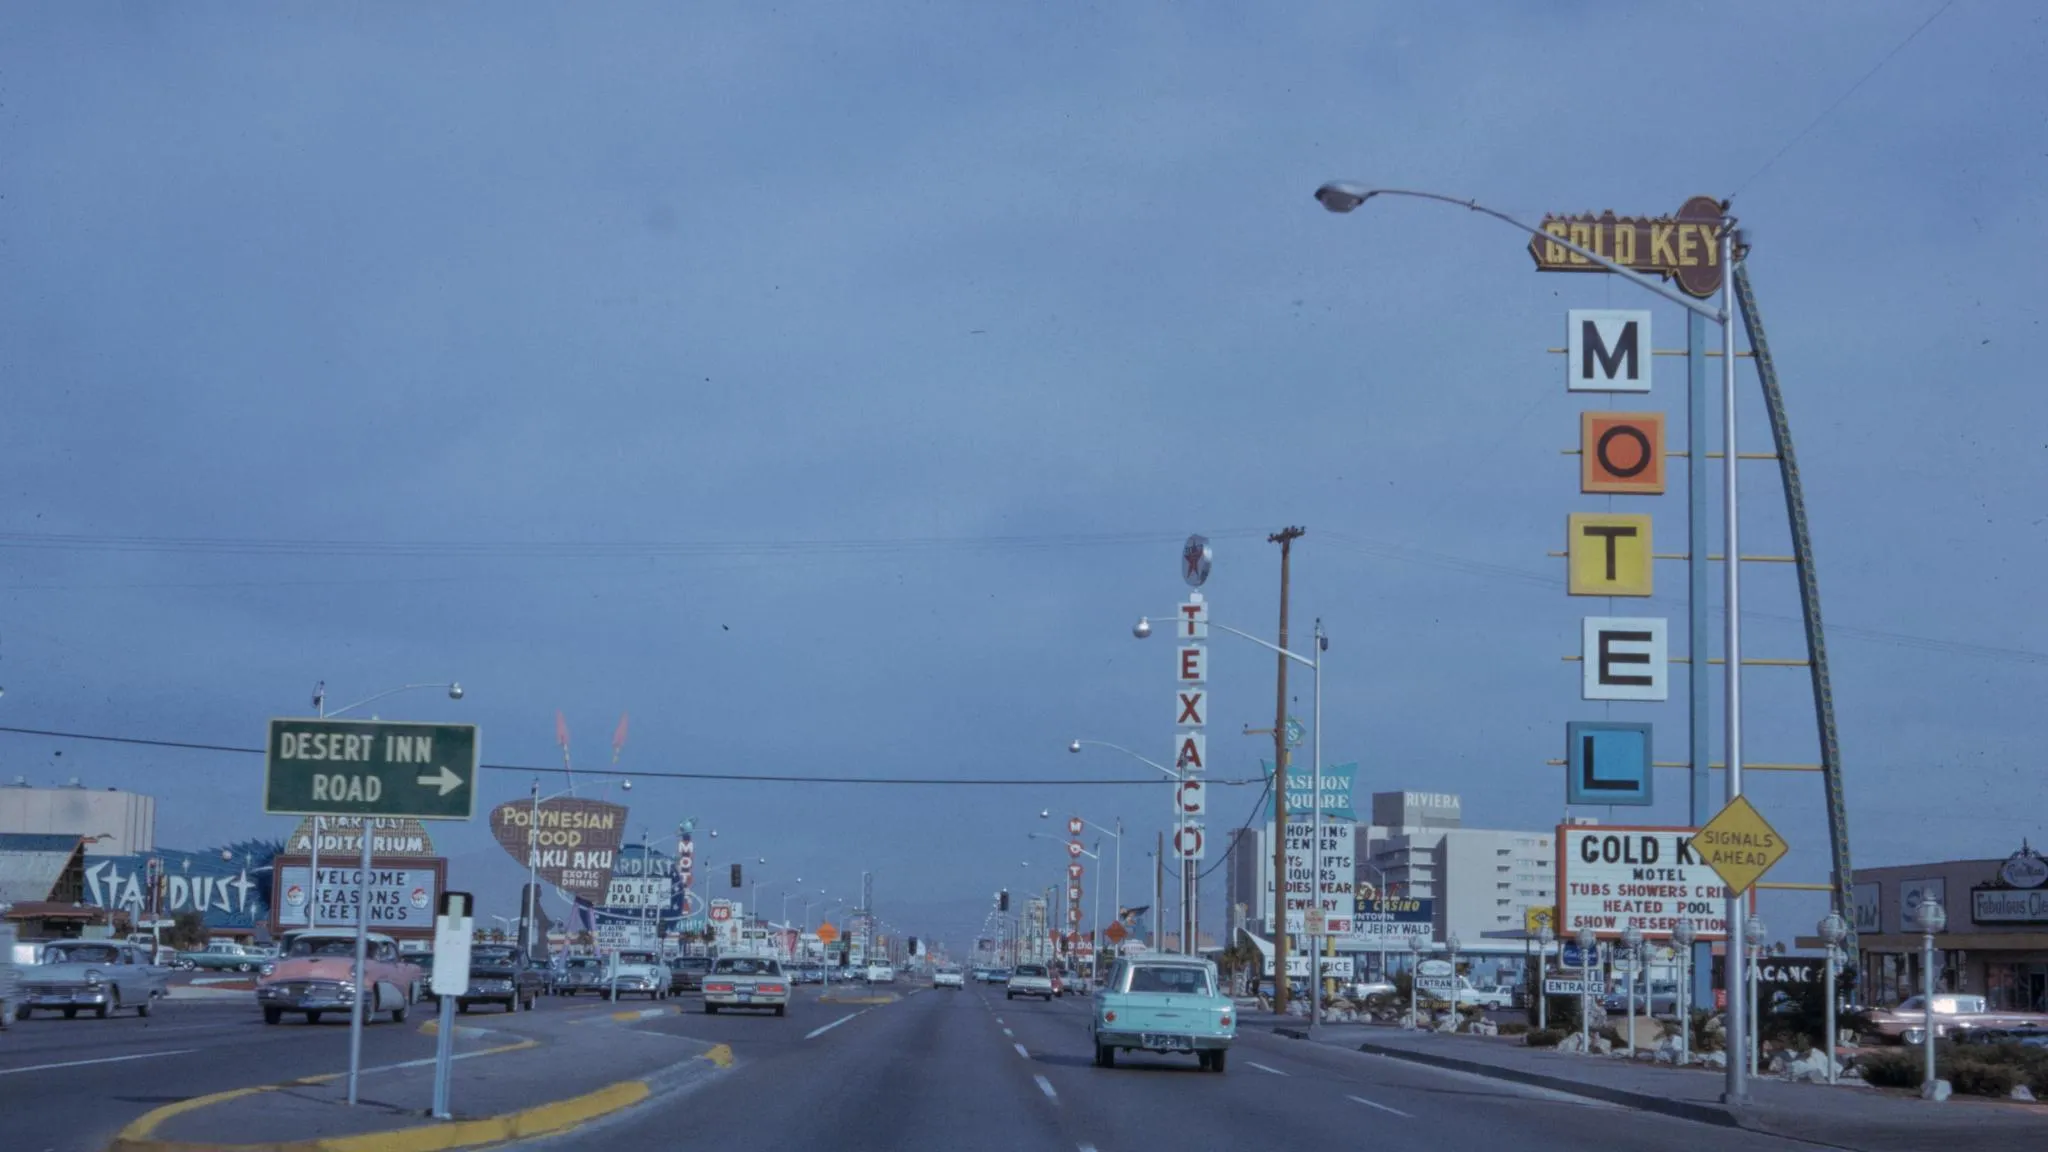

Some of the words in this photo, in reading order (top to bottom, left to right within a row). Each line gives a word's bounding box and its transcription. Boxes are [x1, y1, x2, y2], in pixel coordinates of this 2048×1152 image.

[1546, 223, 1636, 265] GOLD
[1651, 224, 1721, 267] KEY
[1582, 320, 1653, 791] MOTEL
[1174, 605, 1202, 857] TEXACO
[280, 731, 374, 761] DESERT
[386, 735, 433, 763] INN
[312, 773, 382, 802] ROAD
[1271, 775, 1350, 791] ASION
[1285, 793, 1349, 810] QURE
[1406, 791, 1461, 809] RIVIERA
[503, 807, 615, 829] POLYNESIAN
[528, 829, 582, 847] FOOD
[1286, 825, 1348, 838] HOPING
[1285, 838, 1338, 851] CENER
[1703, 830, 1774, 848] SIGNALS
[1581, 835, 1660, 865] GOLD
[529, 849, 568, 868] AKU
[573, 850, 613, 870] AKU
[1321, 856, 1352, 868] IFTS
[1711, 850, 1767, 866] AHEAD
[562, 869, 600, 880] EXOTIC
[1069, 820, 1082, 921] MOTEL
[1288, 868, 1337, 881] IQURS
[1633, 868, 1686, 881] MOTEL
[84, 860, 256, 913] STADUST
[562, 878, 600, 889] DRINKS
[608, 884, 632, 894] IDO
[1267, 881, 1312, 893] LDIES
[1570, 883, 1611, 896] TUBS
[1617, 884, 1688, 898] SHOWERS
[1286, 898, 1338, 911] EWERY
[1373, 900, 1421, 912] CASINO
[1603, 900, 1663, 913] HEATED
[1677, 901, 1715, 914] POOL
[713, 908, 729, 918] 66
[1574, 915, 1616, 928] SHOW
[1402, 923, 1431, 935] WALD
[1267, 960, 1300, 970] PST
[1418, 979, 1462, 988] ENTRANE
